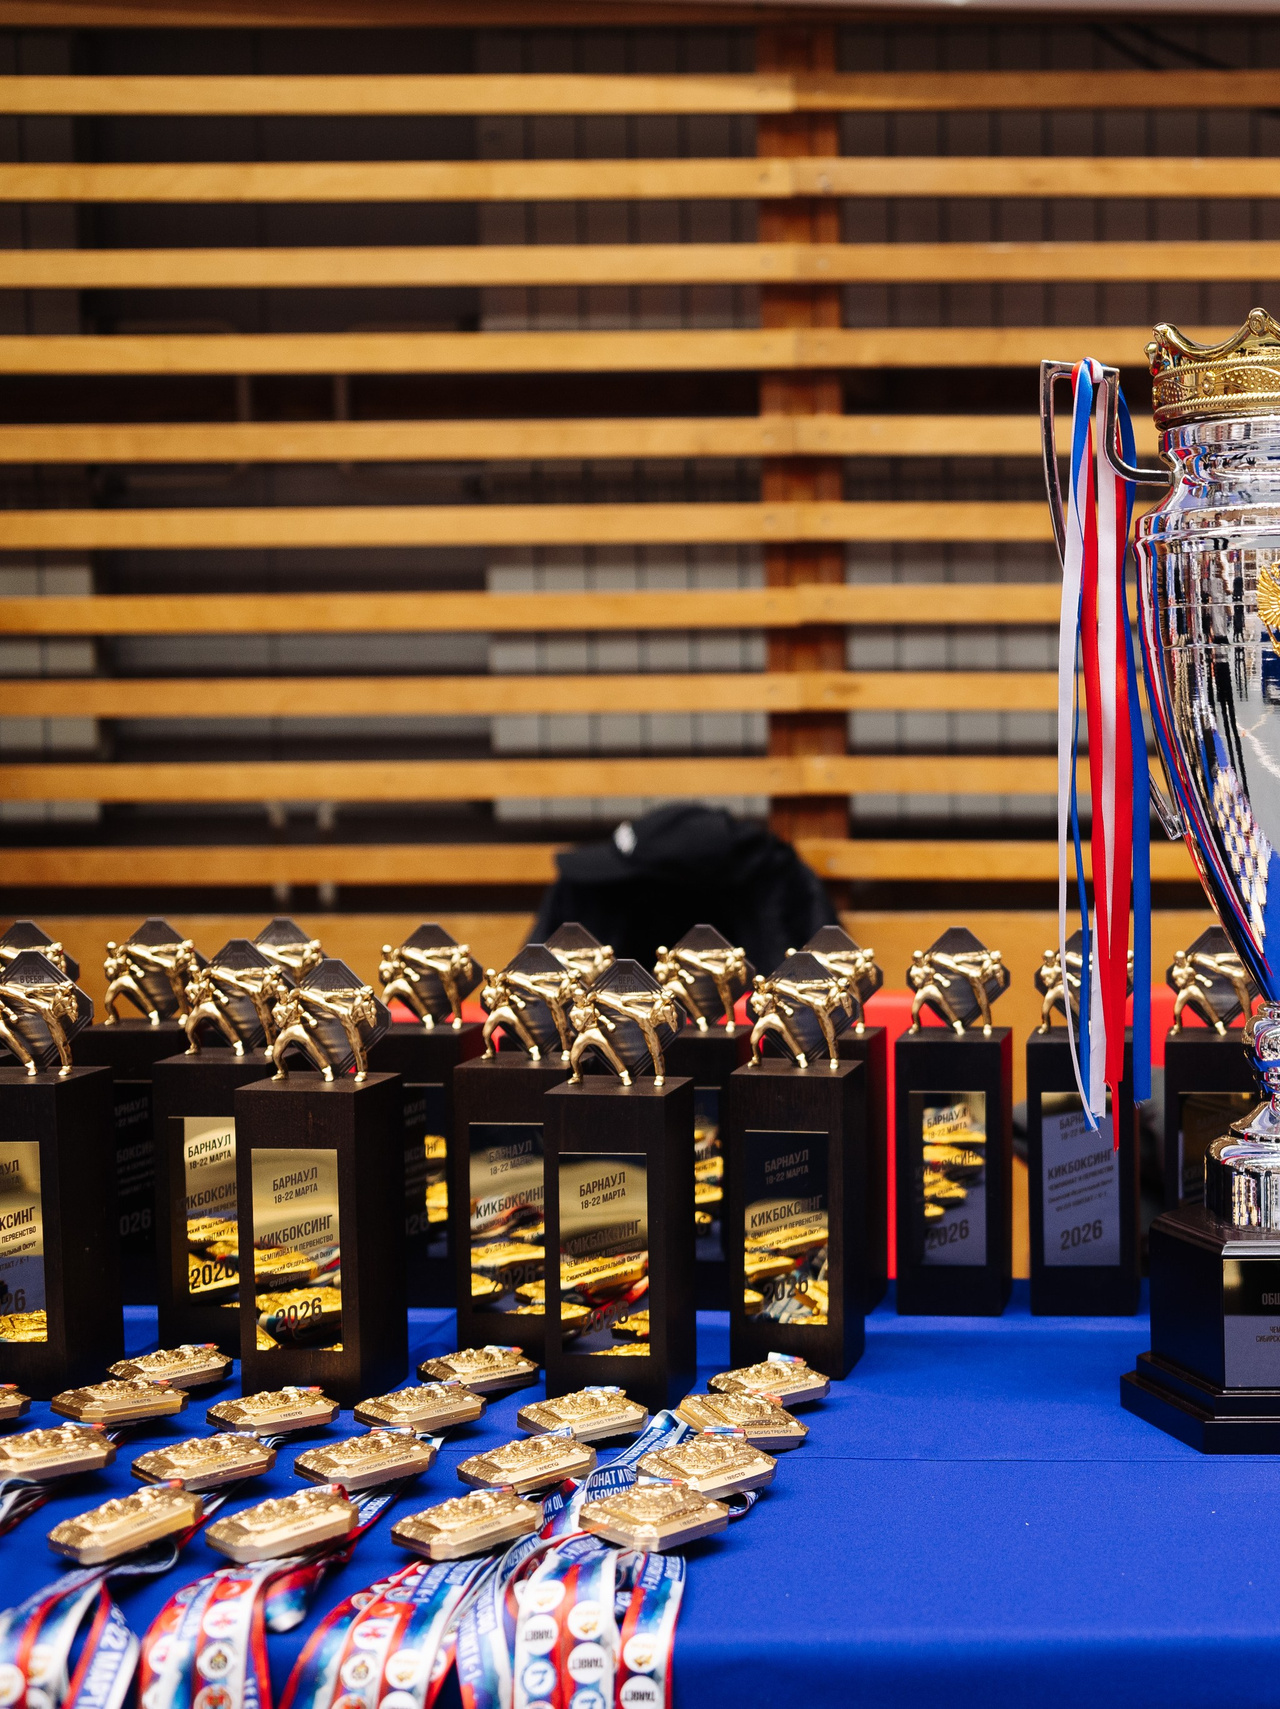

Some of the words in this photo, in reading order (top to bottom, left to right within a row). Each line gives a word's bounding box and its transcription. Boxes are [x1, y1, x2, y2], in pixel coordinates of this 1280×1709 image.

[618, 976, 634, 984] ВЕРЬ
[188, 1134, 231, 1158] БАРНАУЛ
[489, 1140, 532, 1163] БАРНАУЛ
[189, 1158, 208, 1170] 18-22
[210, 1150, 232, 1163] МАРТА
[490, 1162, 508, 1176] 18-22
[765, 1149, 809, 1174] БАРНАУЛ
[1047, 1149, 1111, 1181] КИКБОКСИНГ
[273, 1167, 317, 1191] БАРНАУЛ
[579, 1172, 625, 1197] БАРНАУЛ
[765, 1172, 784, 1185] 18-22
[786, 1165, 809, 1180] МАРТА
[274, 1191, 294, 1204] 18-22
[295, 1183, 318, 1198] МАРТА
[580, 1197, 600, 1210] 18-22
[602, 1188, 626, 1203] МАРТА
[750, 1195, 823, 1228] КИКБОКСИНГ
[1, 1225, 37, 1243] ПЕРВЕНСТВО
[260, 1215, 333, 1250] КИКБОКСИНГ
[566, 1219, 641, 1255] КИКБОКСИНГ
[927, 1219, 969, 1250] 2026
[1060, 1220, 1103, 1251] 2026
[260, 1246, 293, 1262] ЧЕМПИОНАТ
[299, 1234, 333, 1250] ПЕРВЕНСТВО
[191, 1258, 235, 1290] 2026
[762, 1276, 809, 1304] 2026
[276, 1297, 322, 1333] 2026
[581, 1300, 628, 1337] 2026
[539, 1462, 559, 1470] МЕСТО
[728, 1471, 746, 1480] МЕСТО
